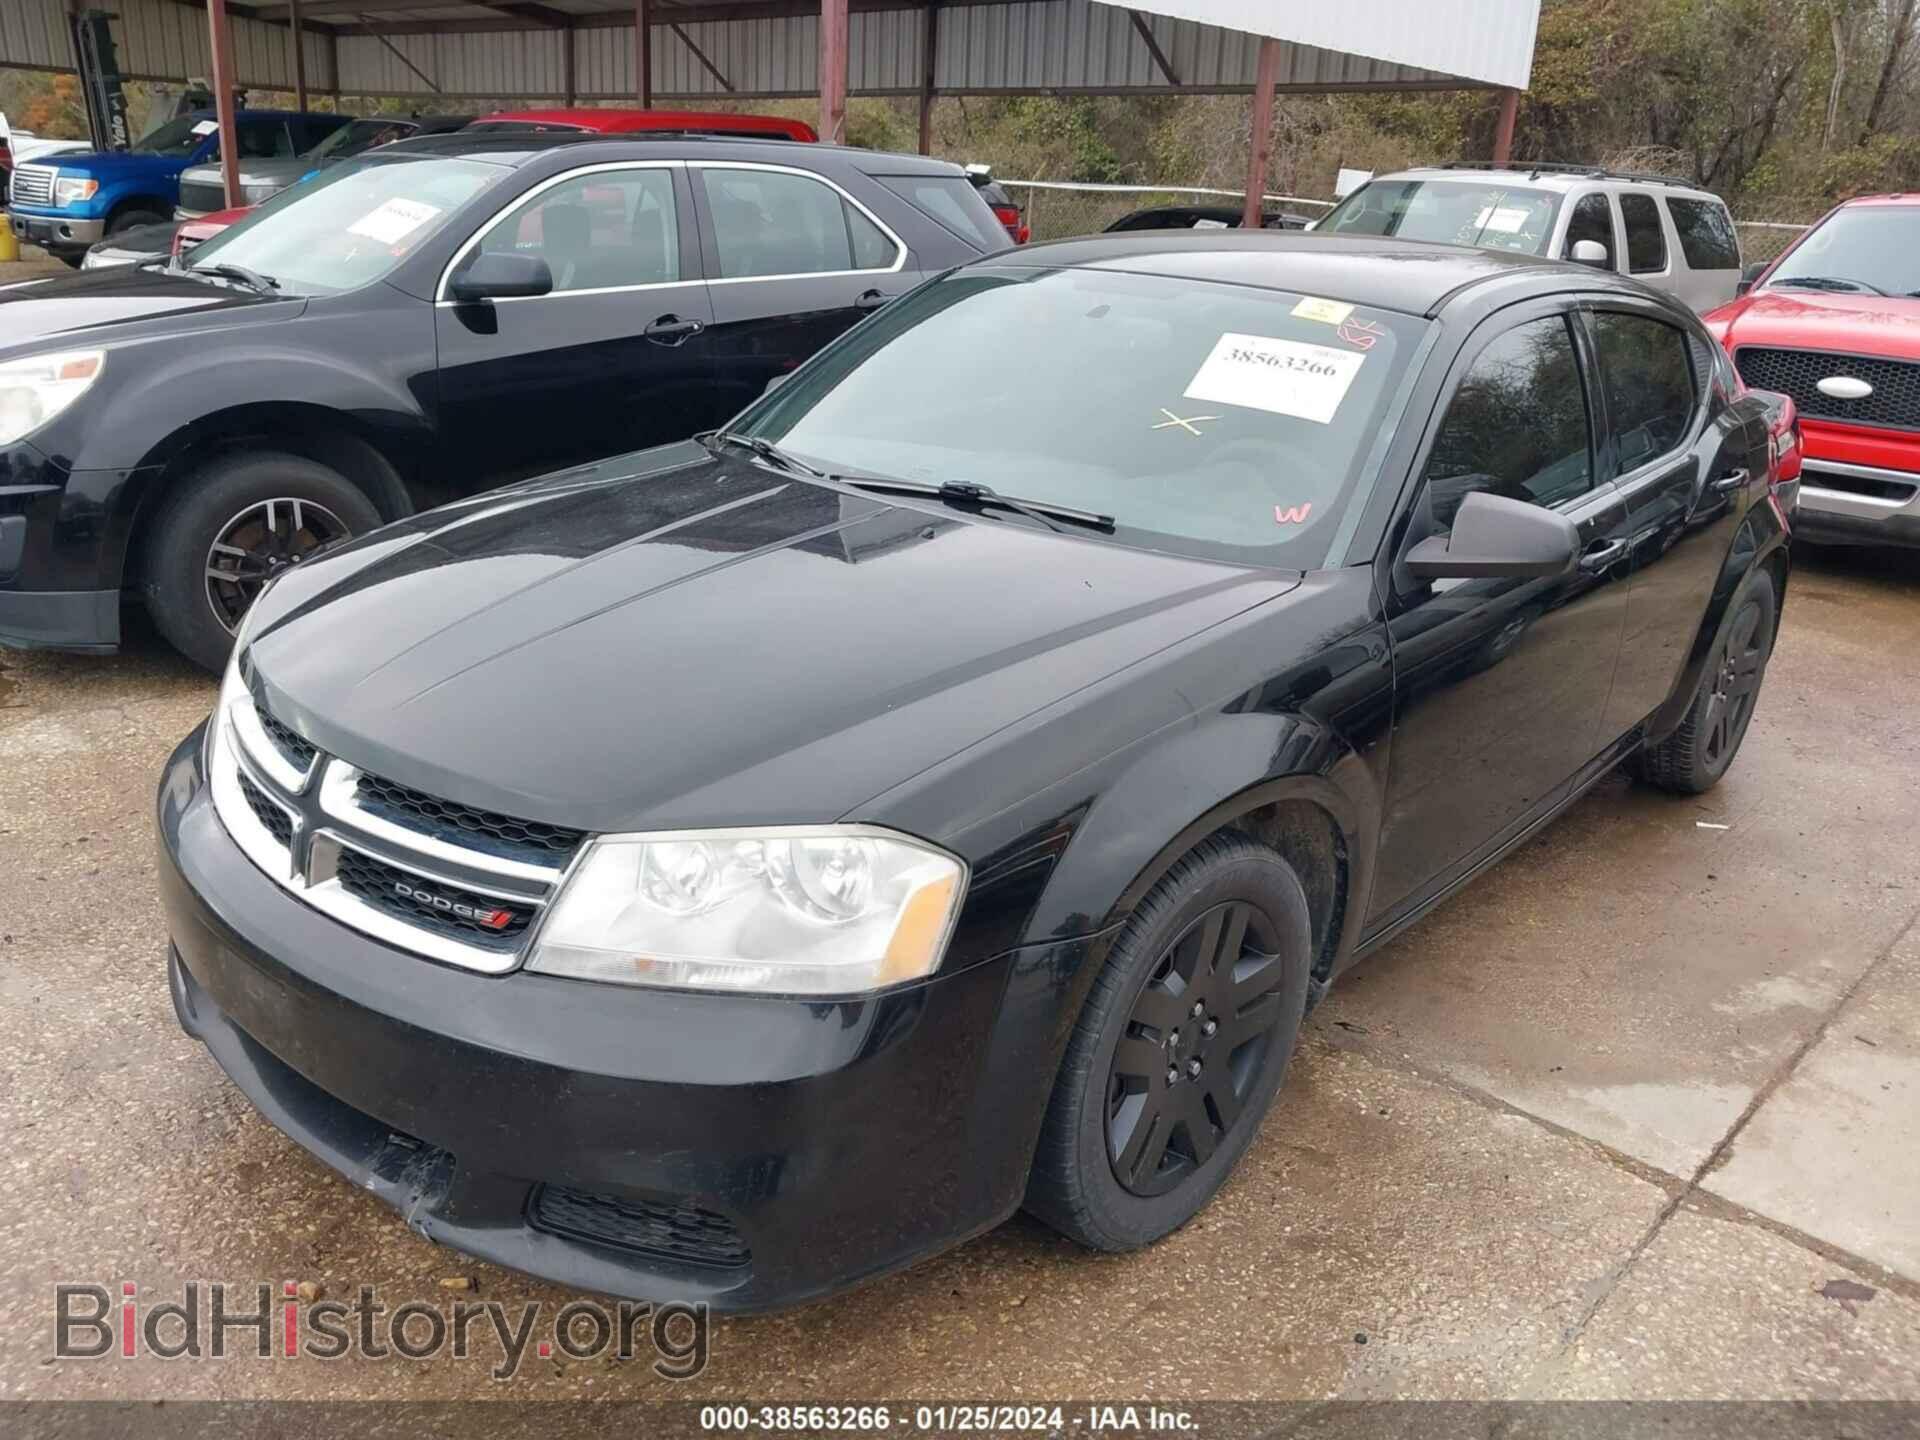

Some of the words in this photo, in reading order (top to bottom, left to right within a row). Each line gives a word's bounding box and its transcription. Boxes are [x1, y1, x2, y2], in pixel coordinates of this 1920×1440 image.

[111, 115, 126, 145] Yale
[1223, 348, 1337, 376] 38563266
[394, 881, 494, 921] DODGE
